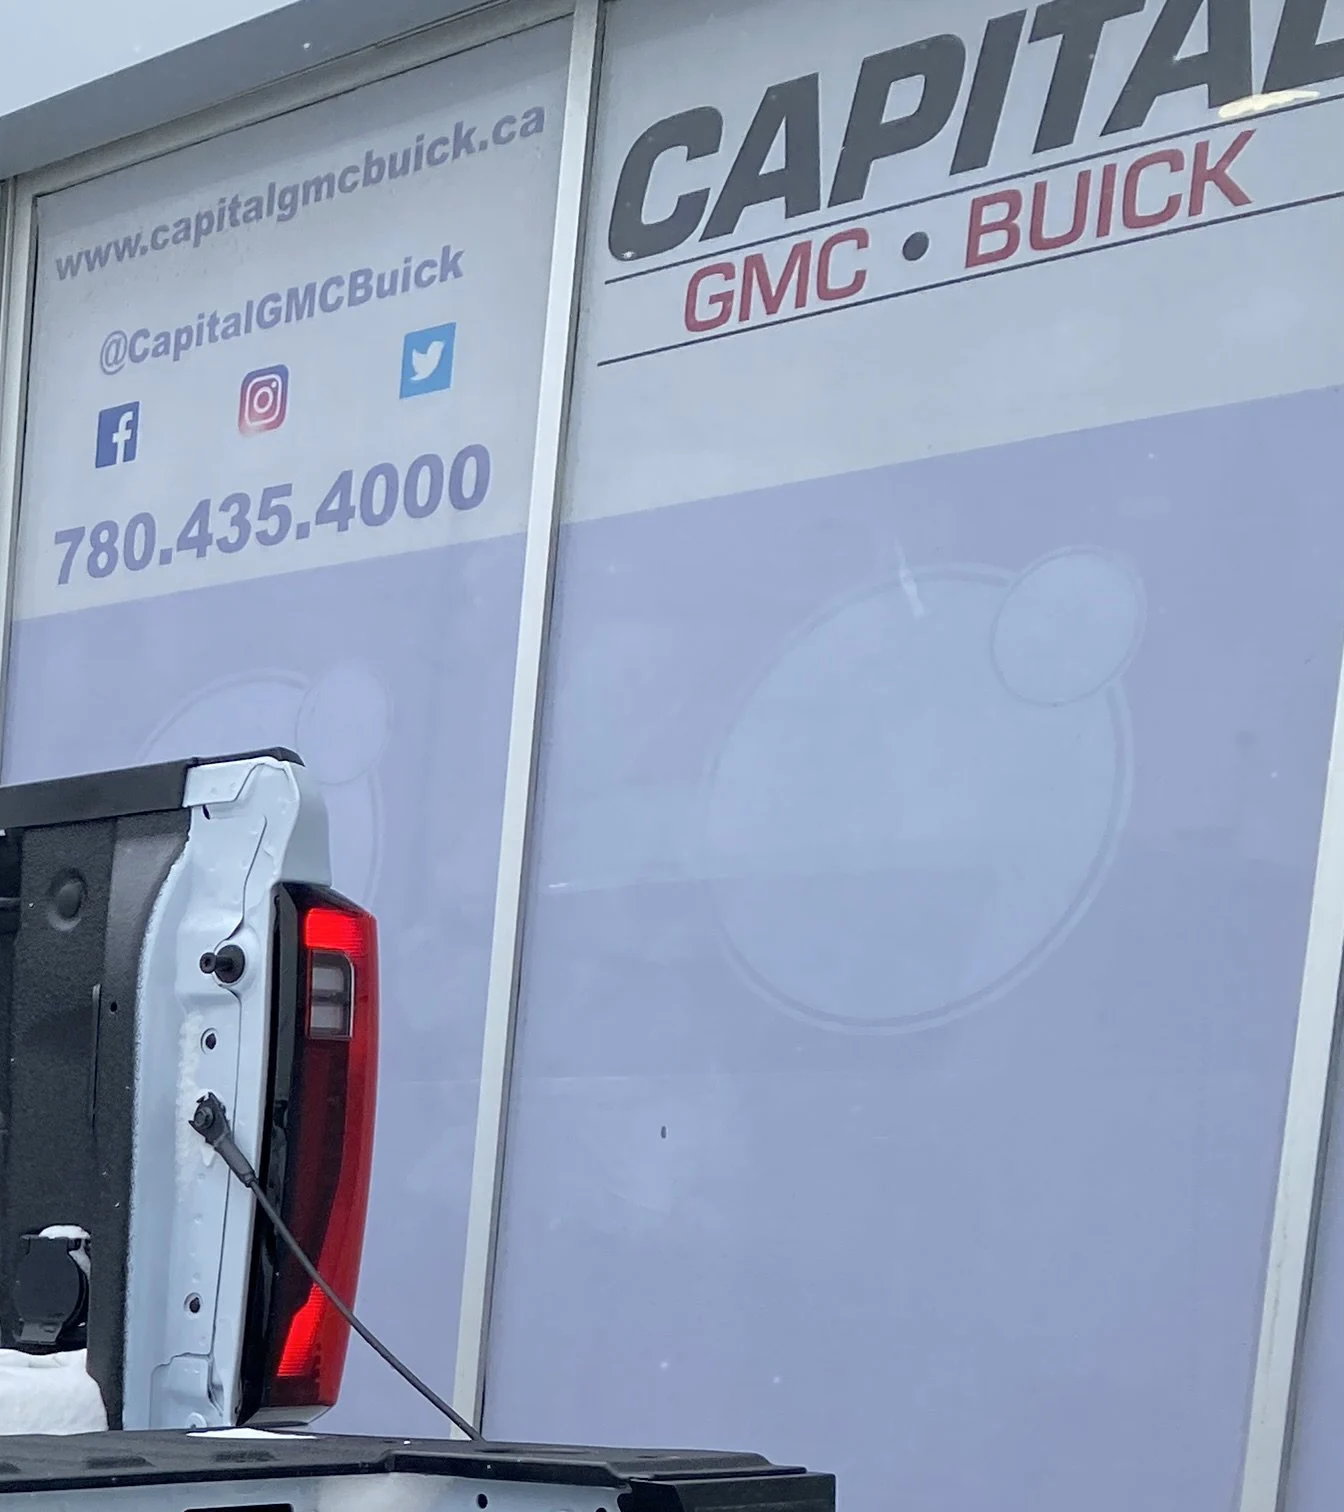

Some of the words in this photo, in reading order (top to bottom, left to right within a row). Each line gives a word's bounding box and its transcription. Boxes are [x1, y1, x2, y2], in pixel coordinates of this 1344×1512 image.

[55, 105, 546, 281] www.capitalgmcbuick.ca
[684, 227, 870, 334] GMC
[964, 129, 1257, 269] BUICK
[99, 244, 465, 376] @CapitalGMCBuick
[54, 443, 492, 586] 780.435.4000
